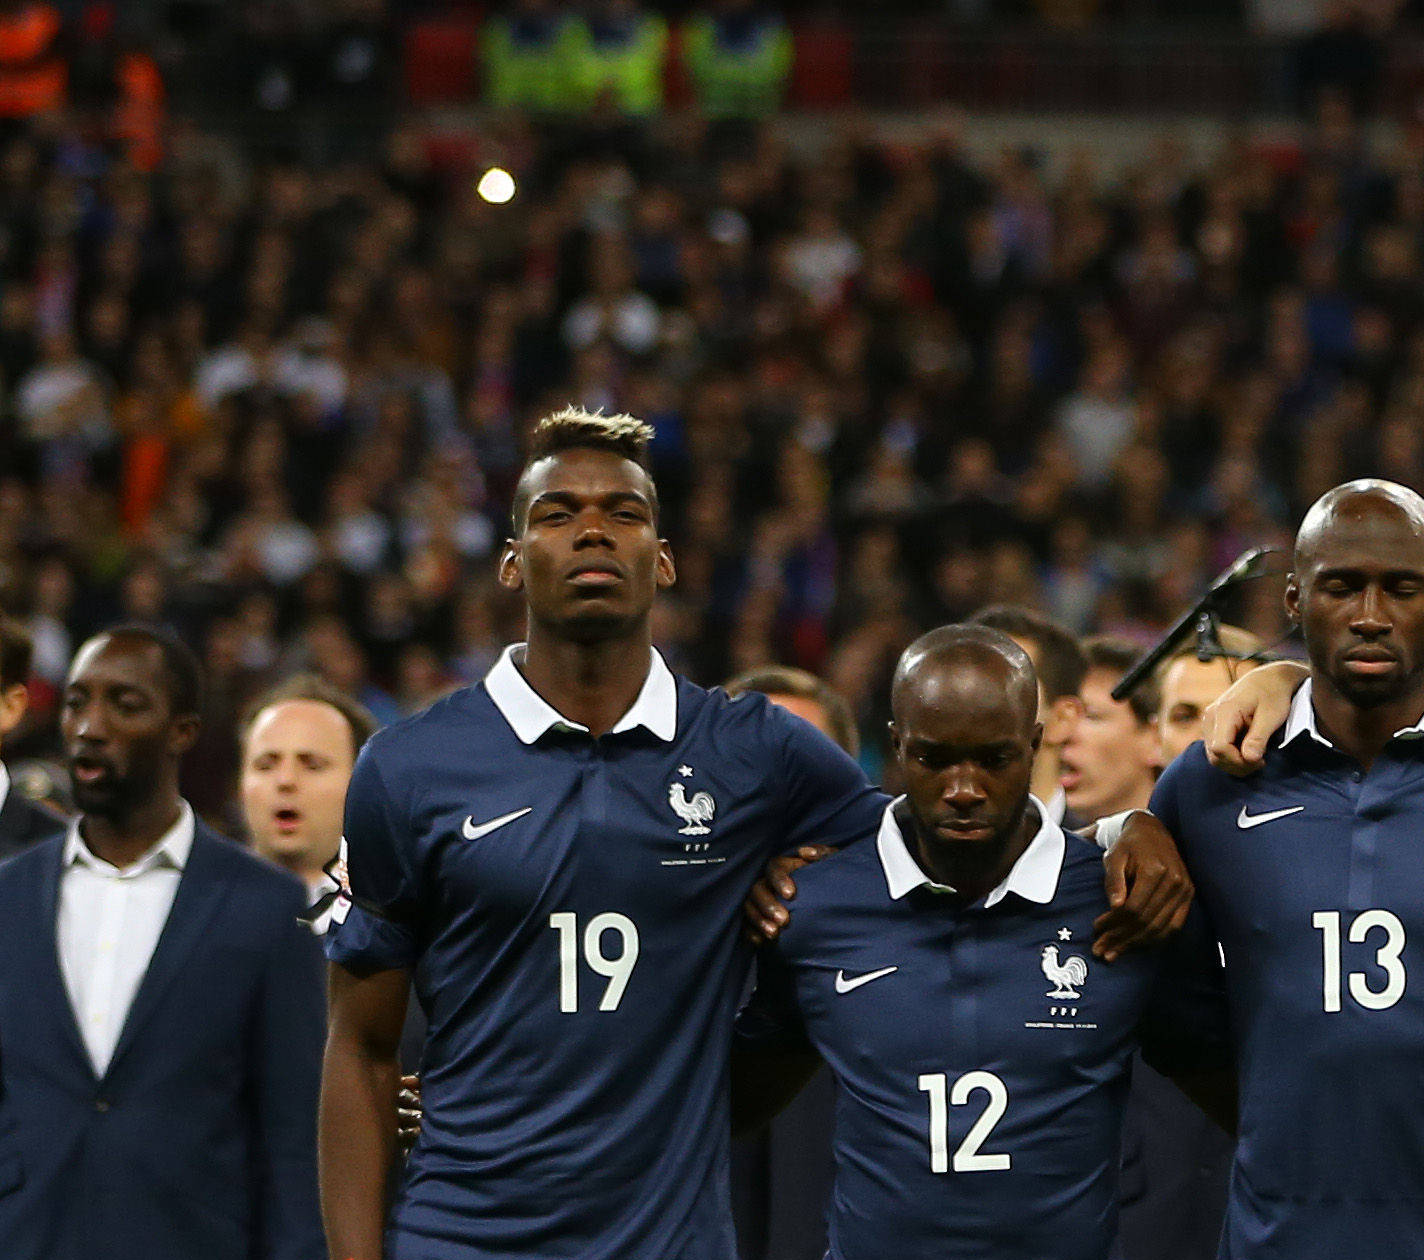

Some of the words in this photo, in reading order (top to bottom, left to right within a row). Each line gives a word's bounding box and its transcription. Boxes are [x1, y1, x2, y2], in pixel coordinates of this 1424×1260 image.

[550, 911, 640, 1013] 19
[1312, 908, 1406, 1012] 13
[917, 1070, 1011, 1174] 12
